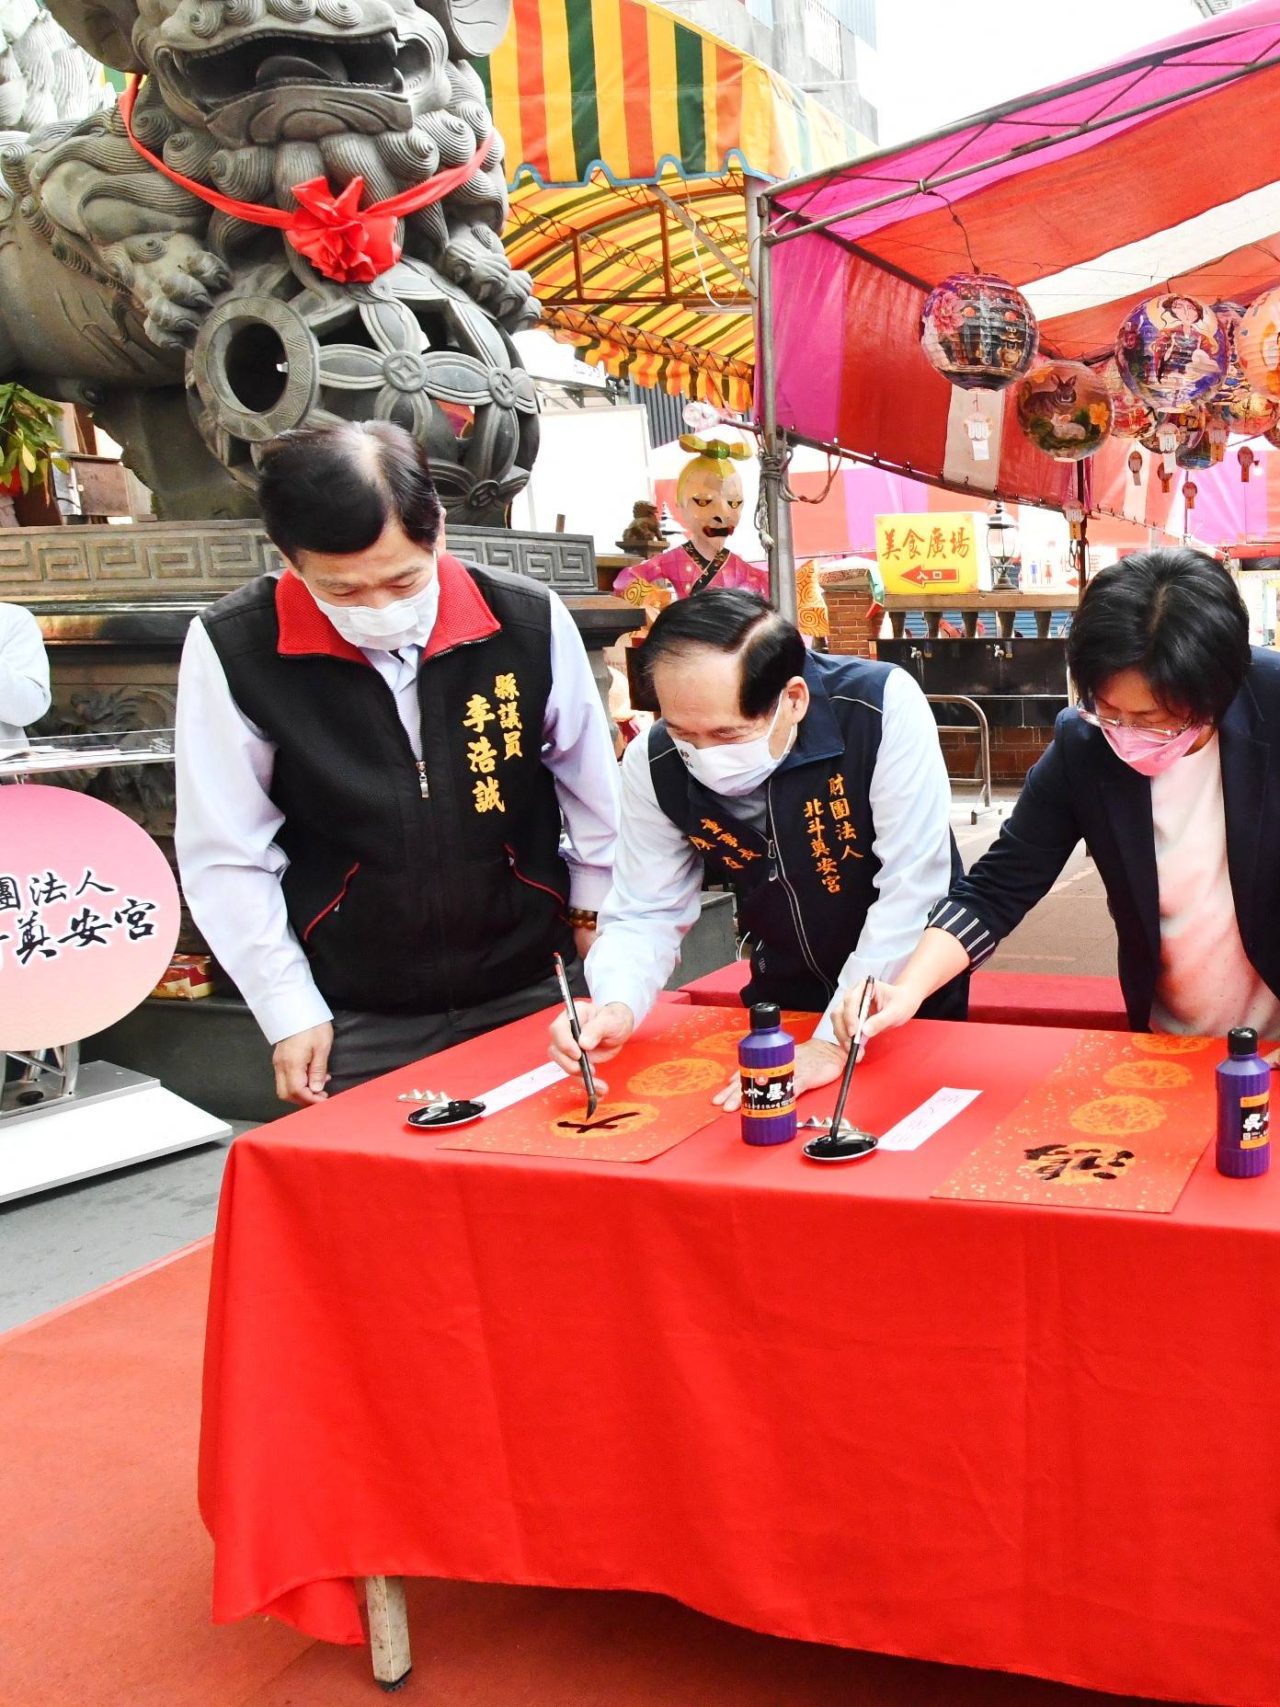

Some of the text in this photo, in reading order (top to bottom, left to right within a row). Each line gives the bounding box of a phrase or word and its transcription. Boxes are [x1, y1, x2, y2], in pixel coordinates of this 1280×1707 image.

[882, 527, 970, 560] 美食廣場
[916, 571, 942, 580] 入口
[462, 693, 505, 813] 李浩誠
[494, 672, 523, 760] 縣議員
[803, 798, 841, 894] 北斗奠安宮
[828, 773, 863, 860] 財團法人
[0, 899, 156, 965] 奠安宮
